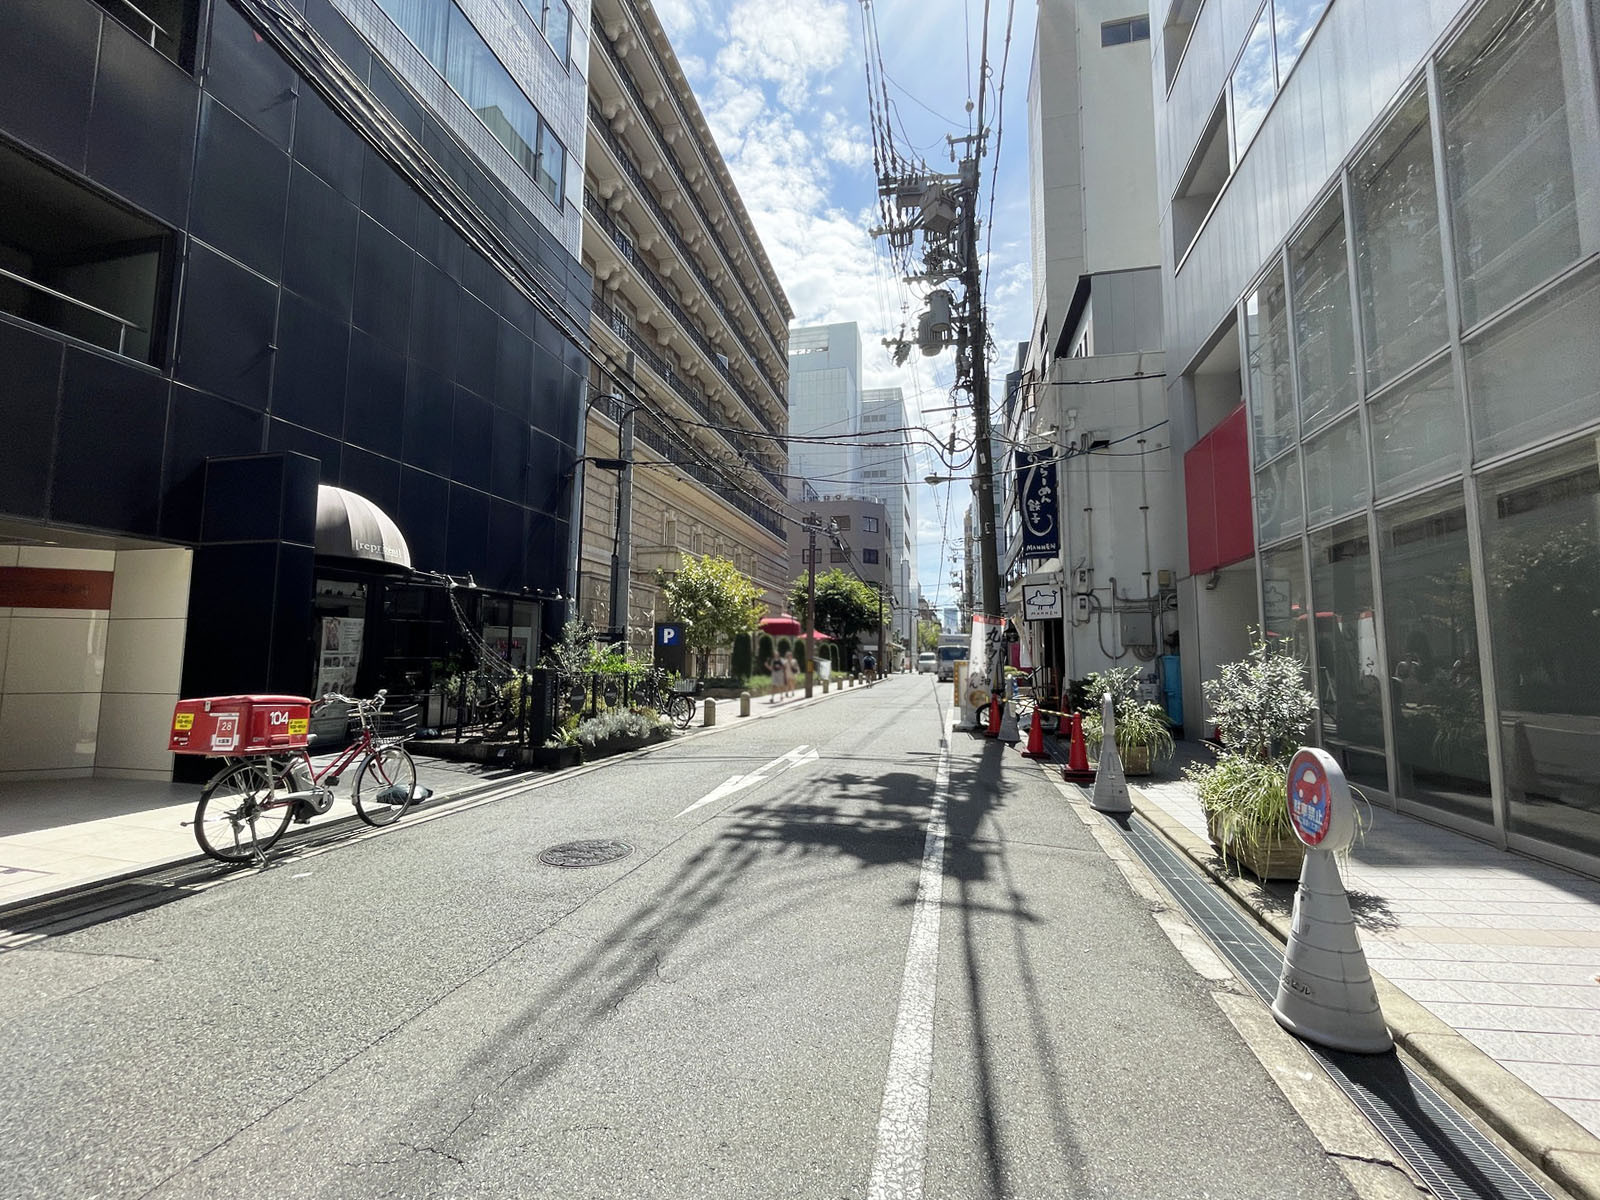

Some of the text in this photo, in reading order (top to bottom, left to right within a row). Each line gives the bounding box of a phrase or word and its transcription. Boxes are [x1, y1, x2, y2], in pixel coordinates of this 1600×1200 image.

[663, 628, 675, 643] P
[269, 711, 289, 725] 104
[221, 721, 232, 731] 28
[1293, 798, 1323, 826] 駐車禁止
